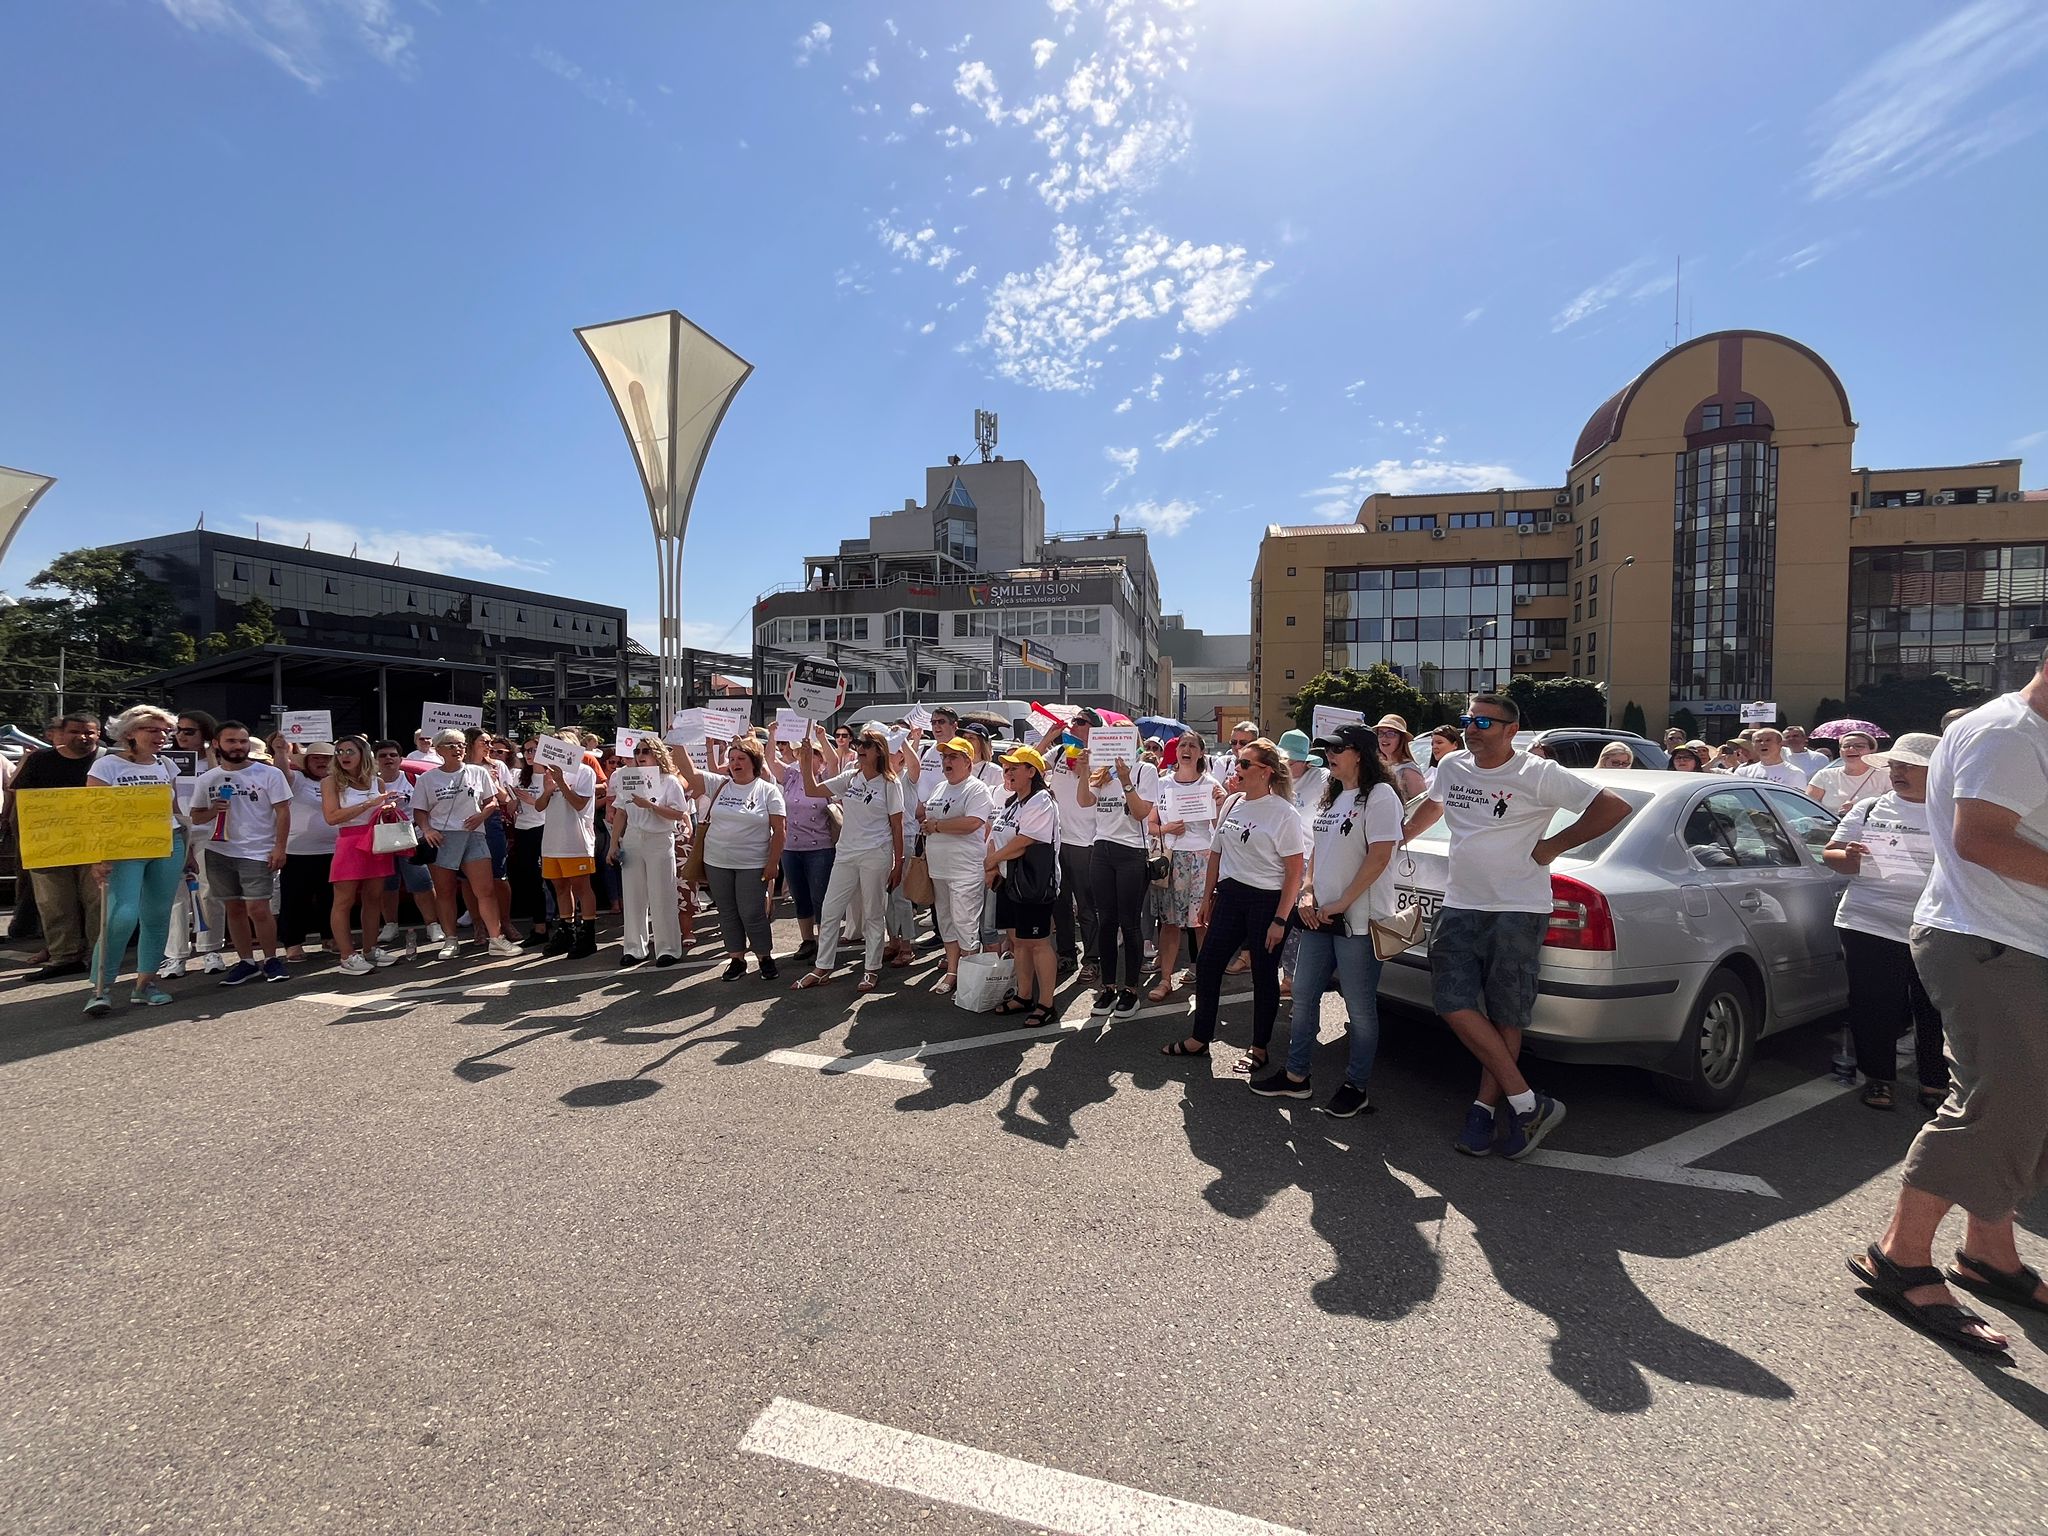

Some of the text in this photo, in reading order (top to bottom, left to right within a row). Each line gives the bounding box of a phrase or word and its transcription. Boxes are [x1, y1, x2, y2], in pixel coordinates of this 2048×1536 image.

[990, 583, 1080, 597] SMILEVISION
[1016, 596, 1067, 604] stomatologică
[1446, 800, 1470, 809] FISCALĂ
